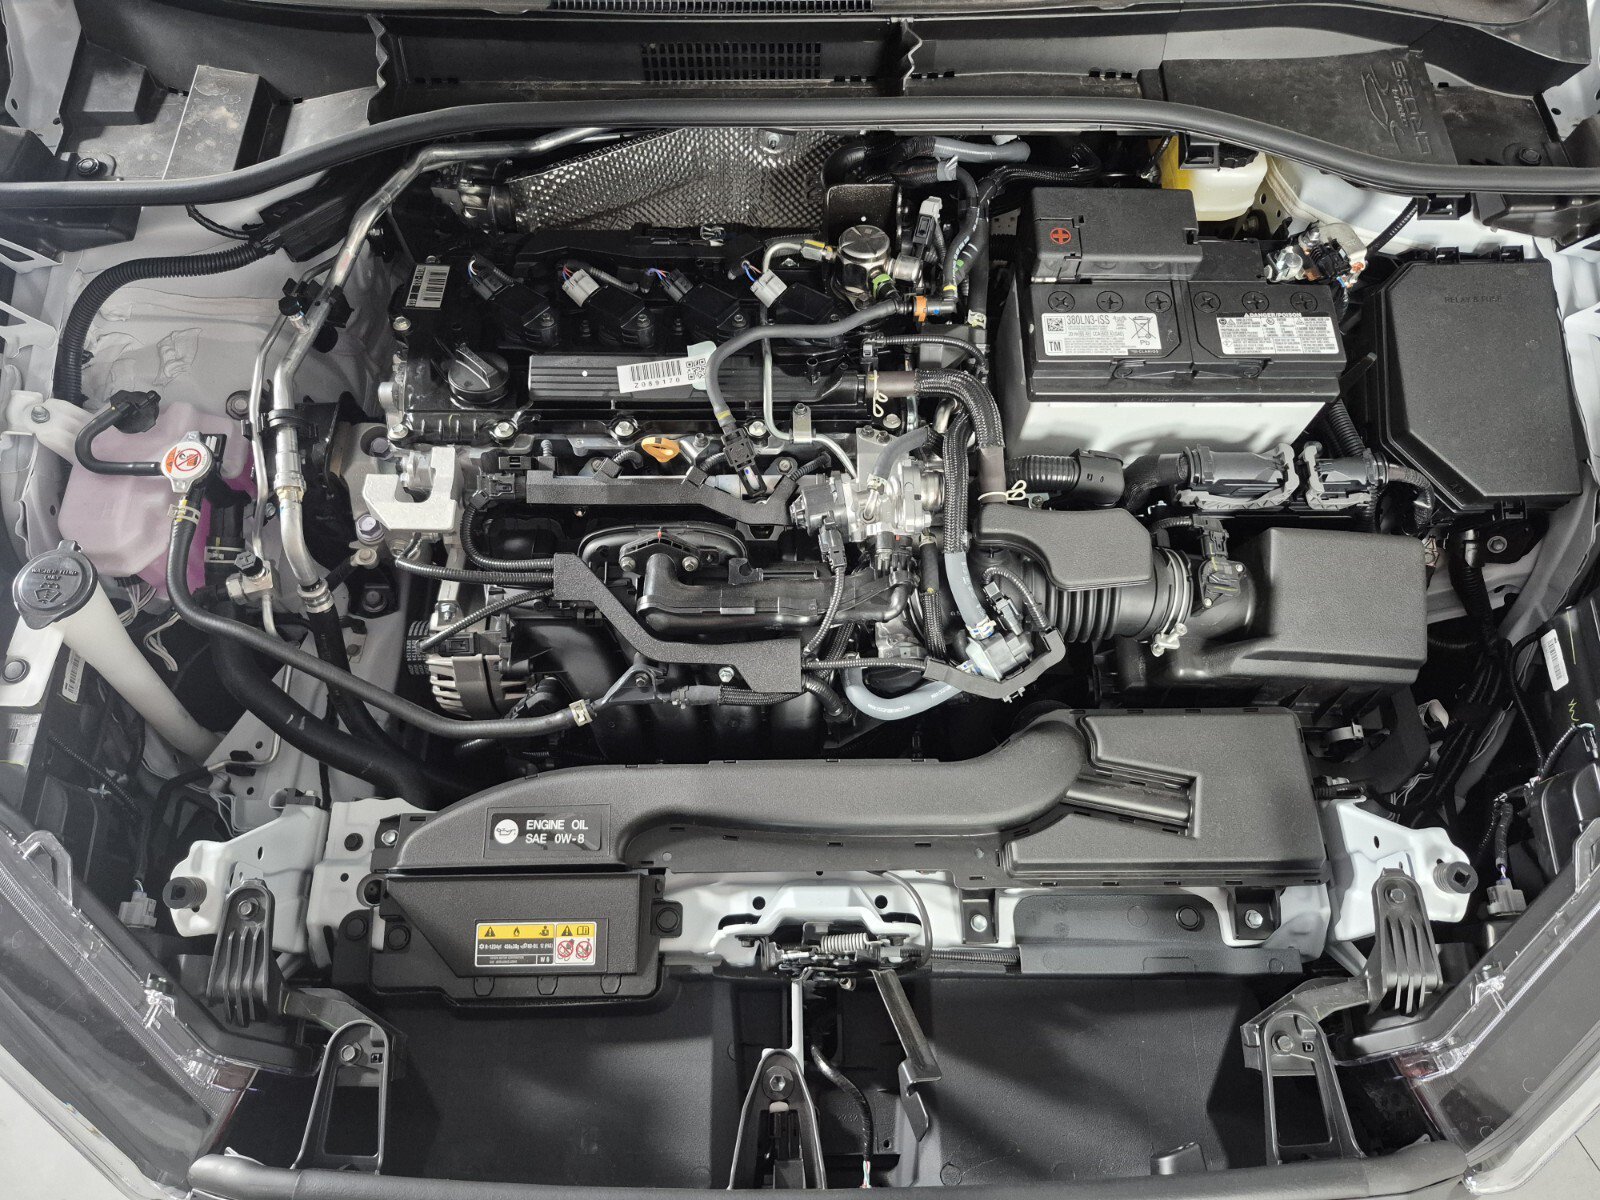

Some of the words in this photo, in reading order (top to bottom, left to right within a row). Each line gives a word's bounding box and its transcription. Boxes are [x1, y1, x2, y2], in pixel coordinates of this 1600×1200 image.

[1048, 341, 1062, 351] TM
[526, 819, 565, 830] ENGINE
[571, 819, 588, 830] OIL
[525, 833, 547, 844] SAE
[554, 833, 585, 844] 0W-8
